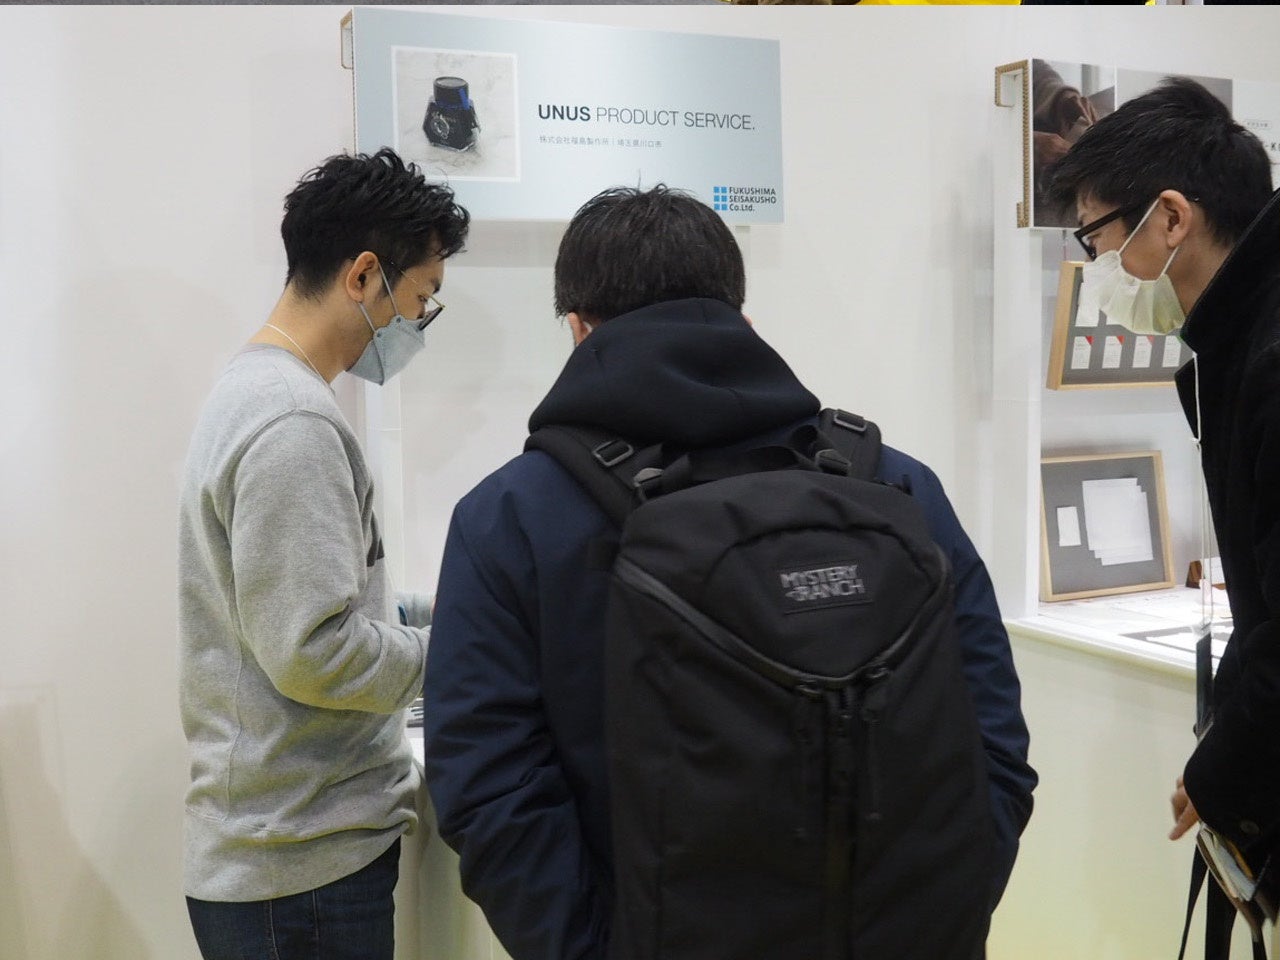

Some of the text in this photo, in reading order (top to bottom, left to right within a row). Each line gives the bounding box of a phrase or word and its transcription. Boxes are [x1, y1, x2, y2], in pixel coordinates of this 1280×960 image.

[538, 104, 756, 131] UNUS PRODUCT SERVICE.
[729, 186, 777, 196] FUKUSHIMA
[729, 195, 777, 204] SEISAKUSHO
